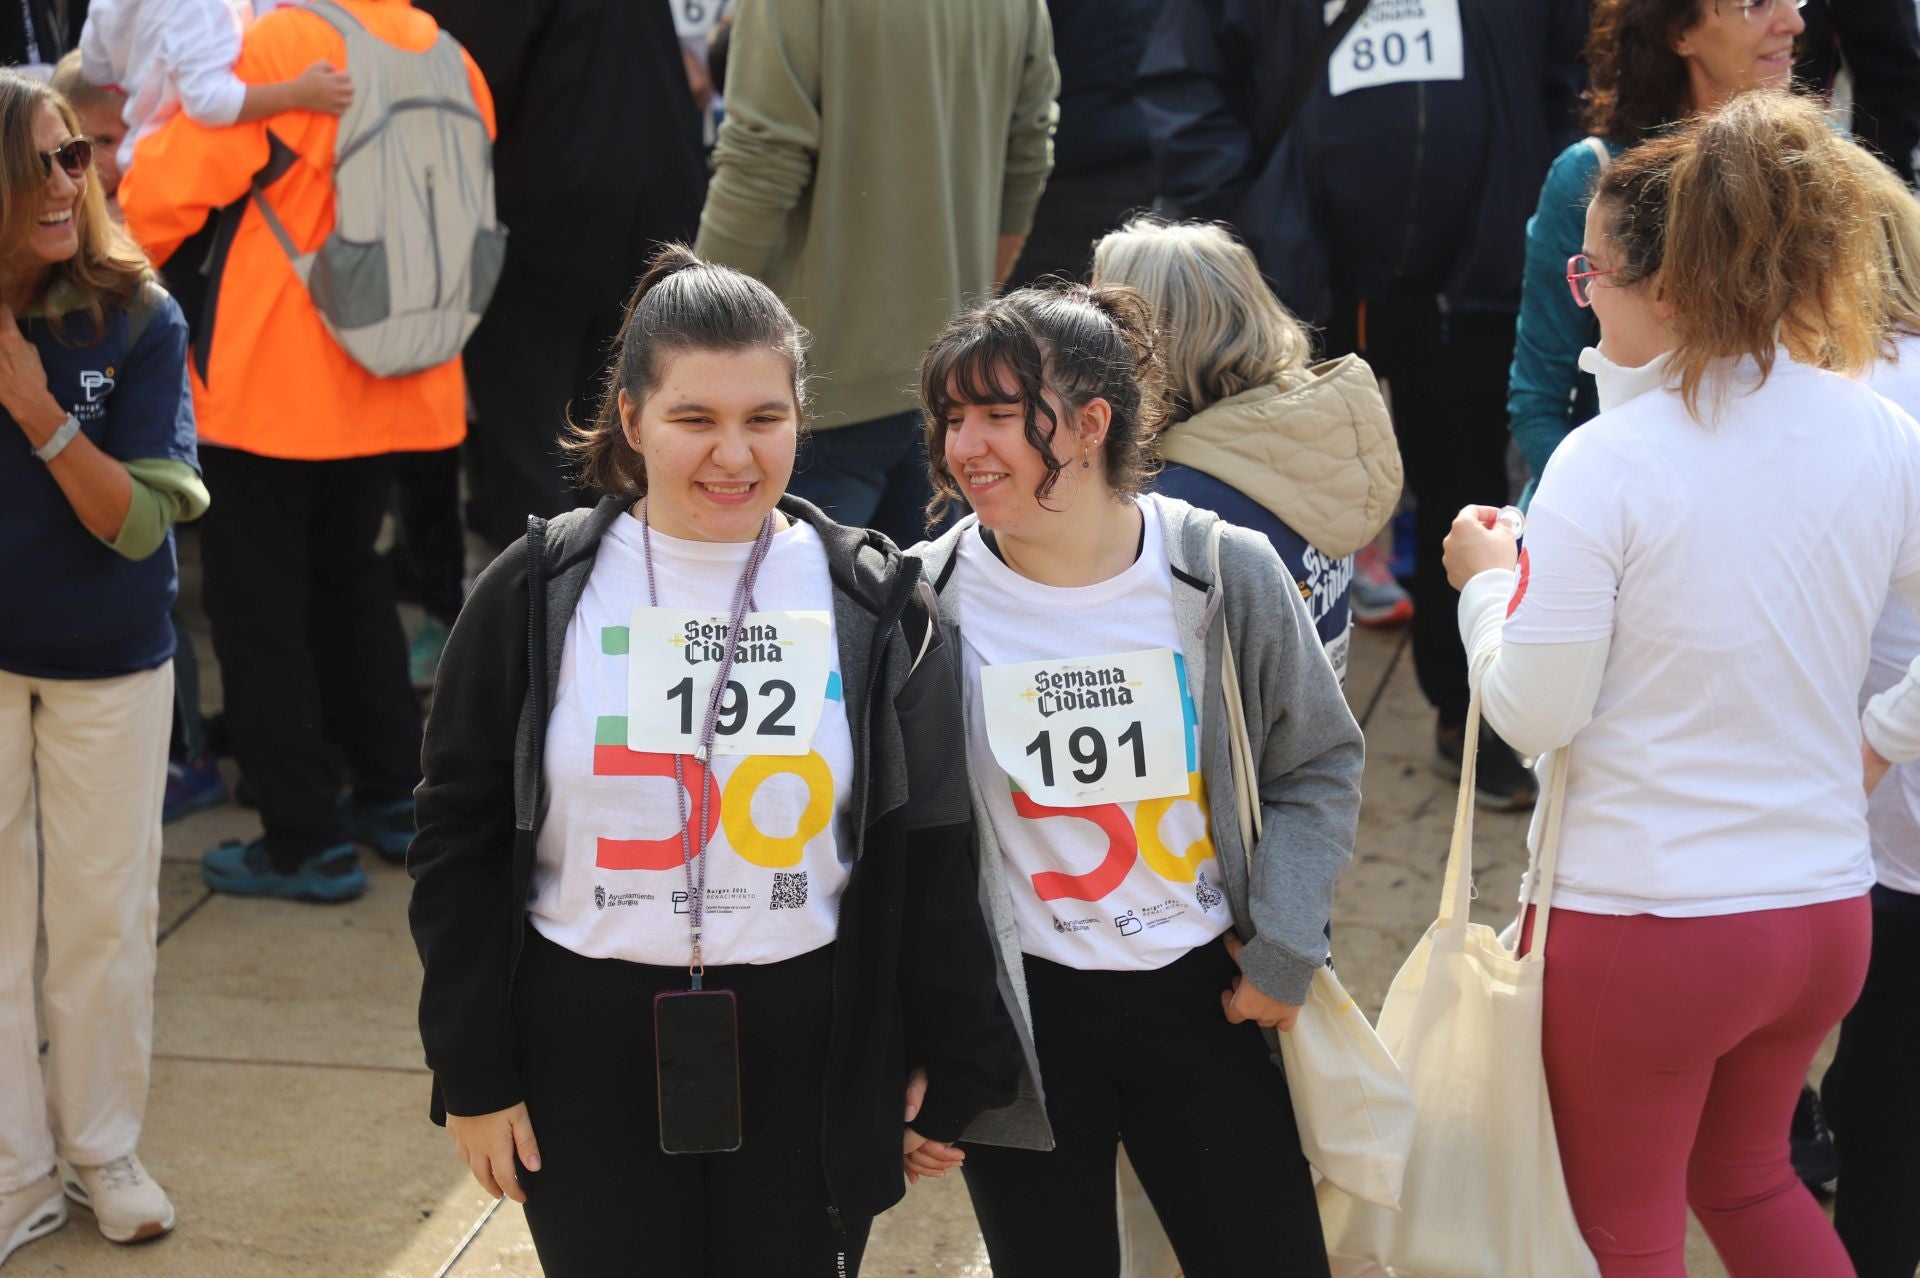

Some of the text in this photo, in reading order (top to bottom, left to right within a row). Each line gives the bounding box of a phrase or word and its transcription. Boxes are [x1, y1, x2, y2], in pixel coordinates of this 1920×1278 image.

[1353, 28, 1433, 71] 801
[684, 640, 783, 665] Cidana
[1034, 667, 1126, 693] Semana
[666, 677, 797, 736] 192
[1037, 686, 1134, 718] Cidiana
[1025, 720, 1147, 787] 191
[608, 893, 655, 901] Ayuntamiento
